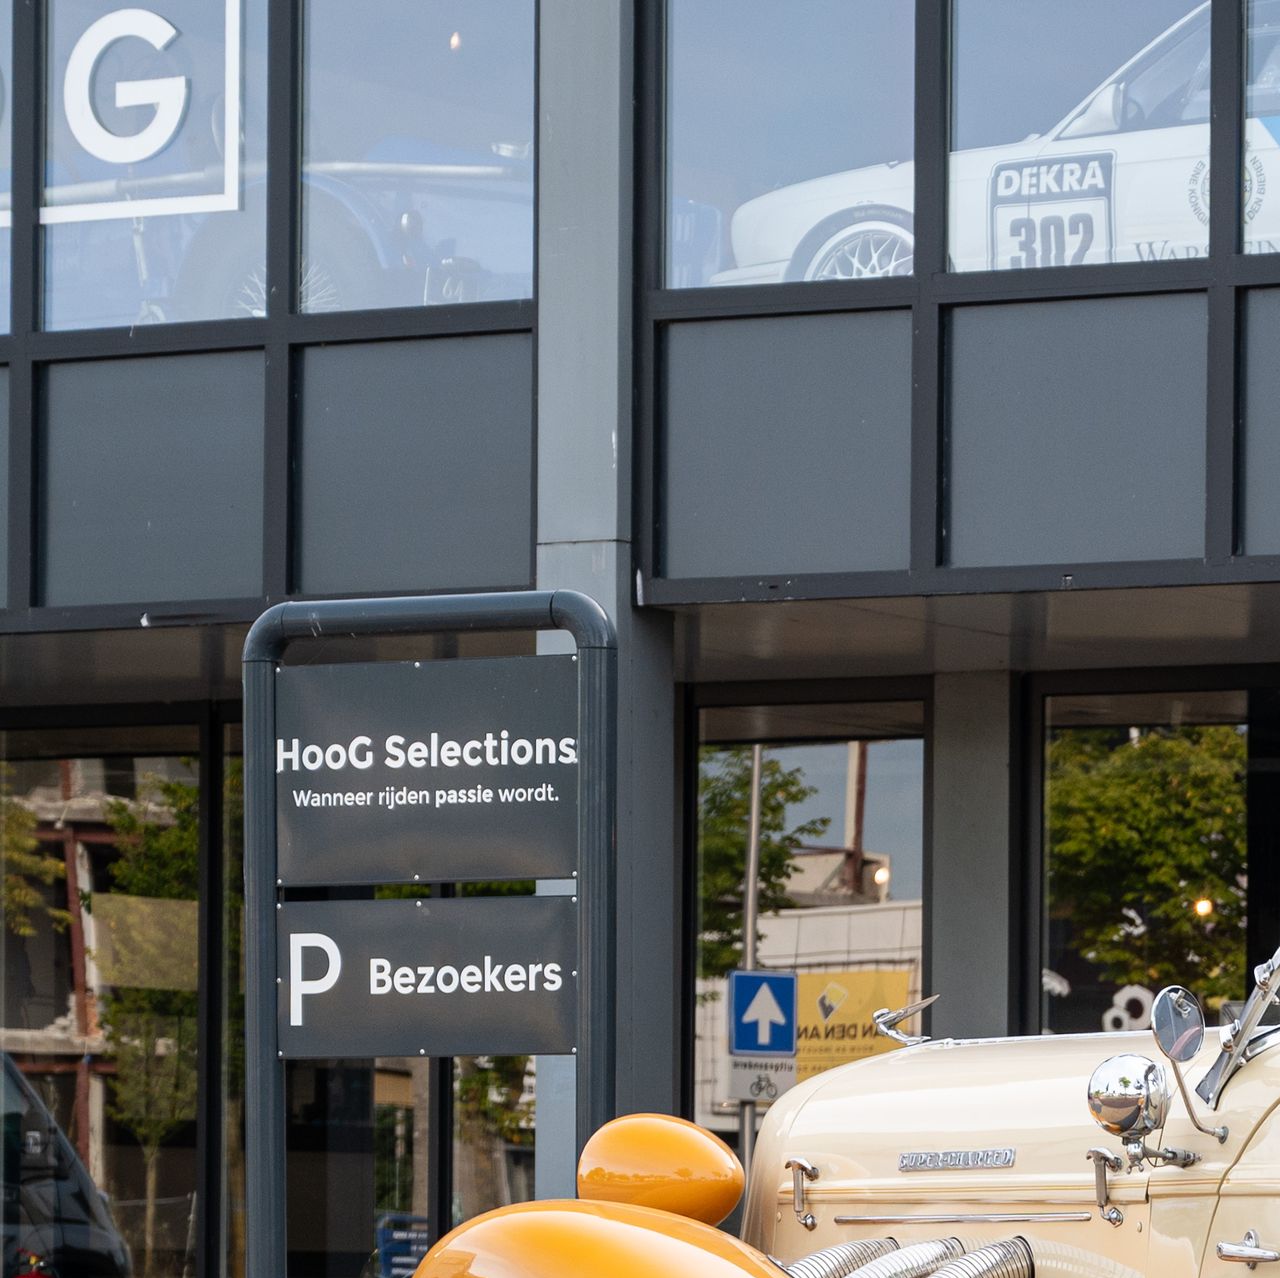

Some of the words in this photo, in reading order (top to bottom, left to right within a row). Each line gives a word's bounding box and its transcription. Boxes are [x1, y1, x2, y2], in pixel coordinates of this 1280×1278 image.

[997, 160, 1105, 196] DEKRA
[1009, 213, 1094, 268] 302
[277, 736, 373, 771] HooG
[384, 730, 577, 769] Selections
[293, 789, 373, 807] Wanneer
[378, 786, 430, 809] rijden
[435, 784, 493, 808] passie
[498, 783, 559, 802] wordt.
[290, 933, 342, 1026] P
[369, 956, 562, 994] Bezoekers
